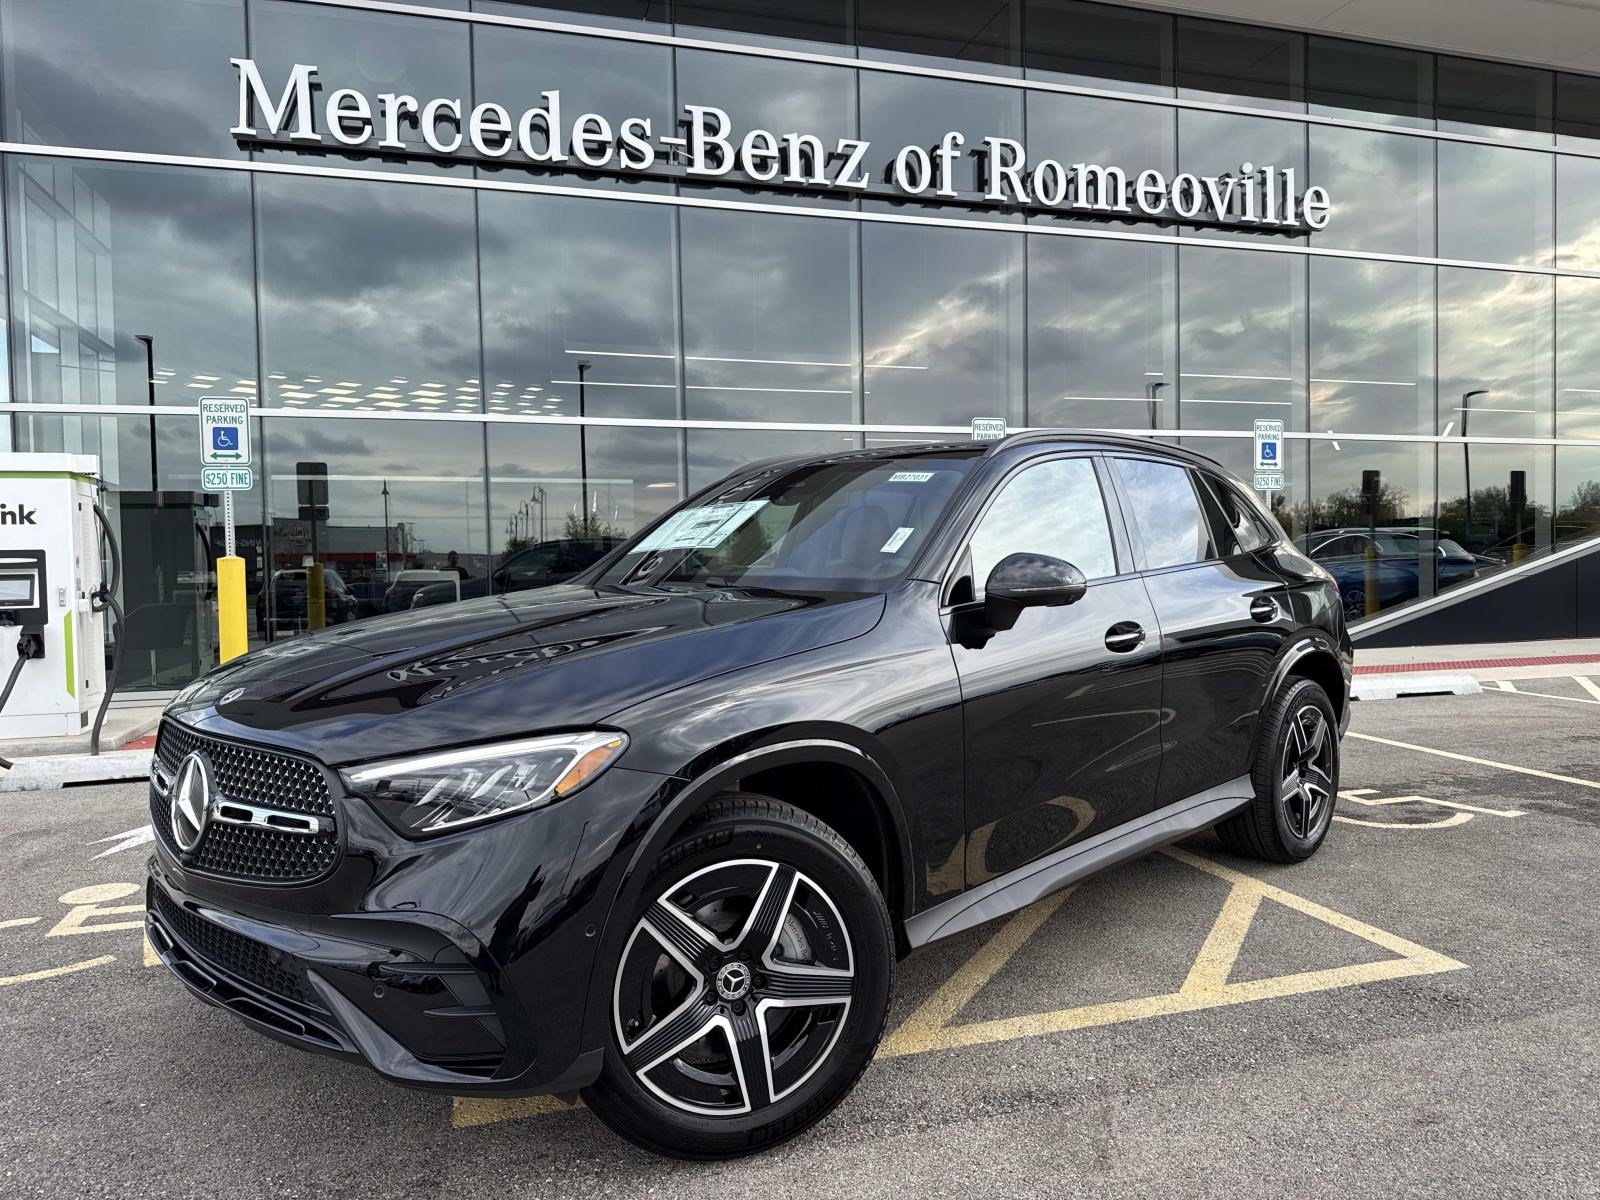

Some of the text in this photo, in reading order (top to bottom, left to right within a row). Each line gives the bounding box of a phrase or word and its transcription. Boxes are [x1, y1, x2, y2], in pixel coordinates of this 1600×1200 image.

[230, 57, 1331, 230] Mercedes-Benz of Romeoville
[203, 403, 246, 413] RESERVED
[206, 415, 244, 425] PARKING
[974, 424, 1004, 432] RESERVED
[1256, 424, 1281, 432] RESERVED
[1258, 433, 1280, 441] PARKING
[205, 472, 249, 486] $250 FINE
[1256, 476, 1282, 487] $250 FINE
